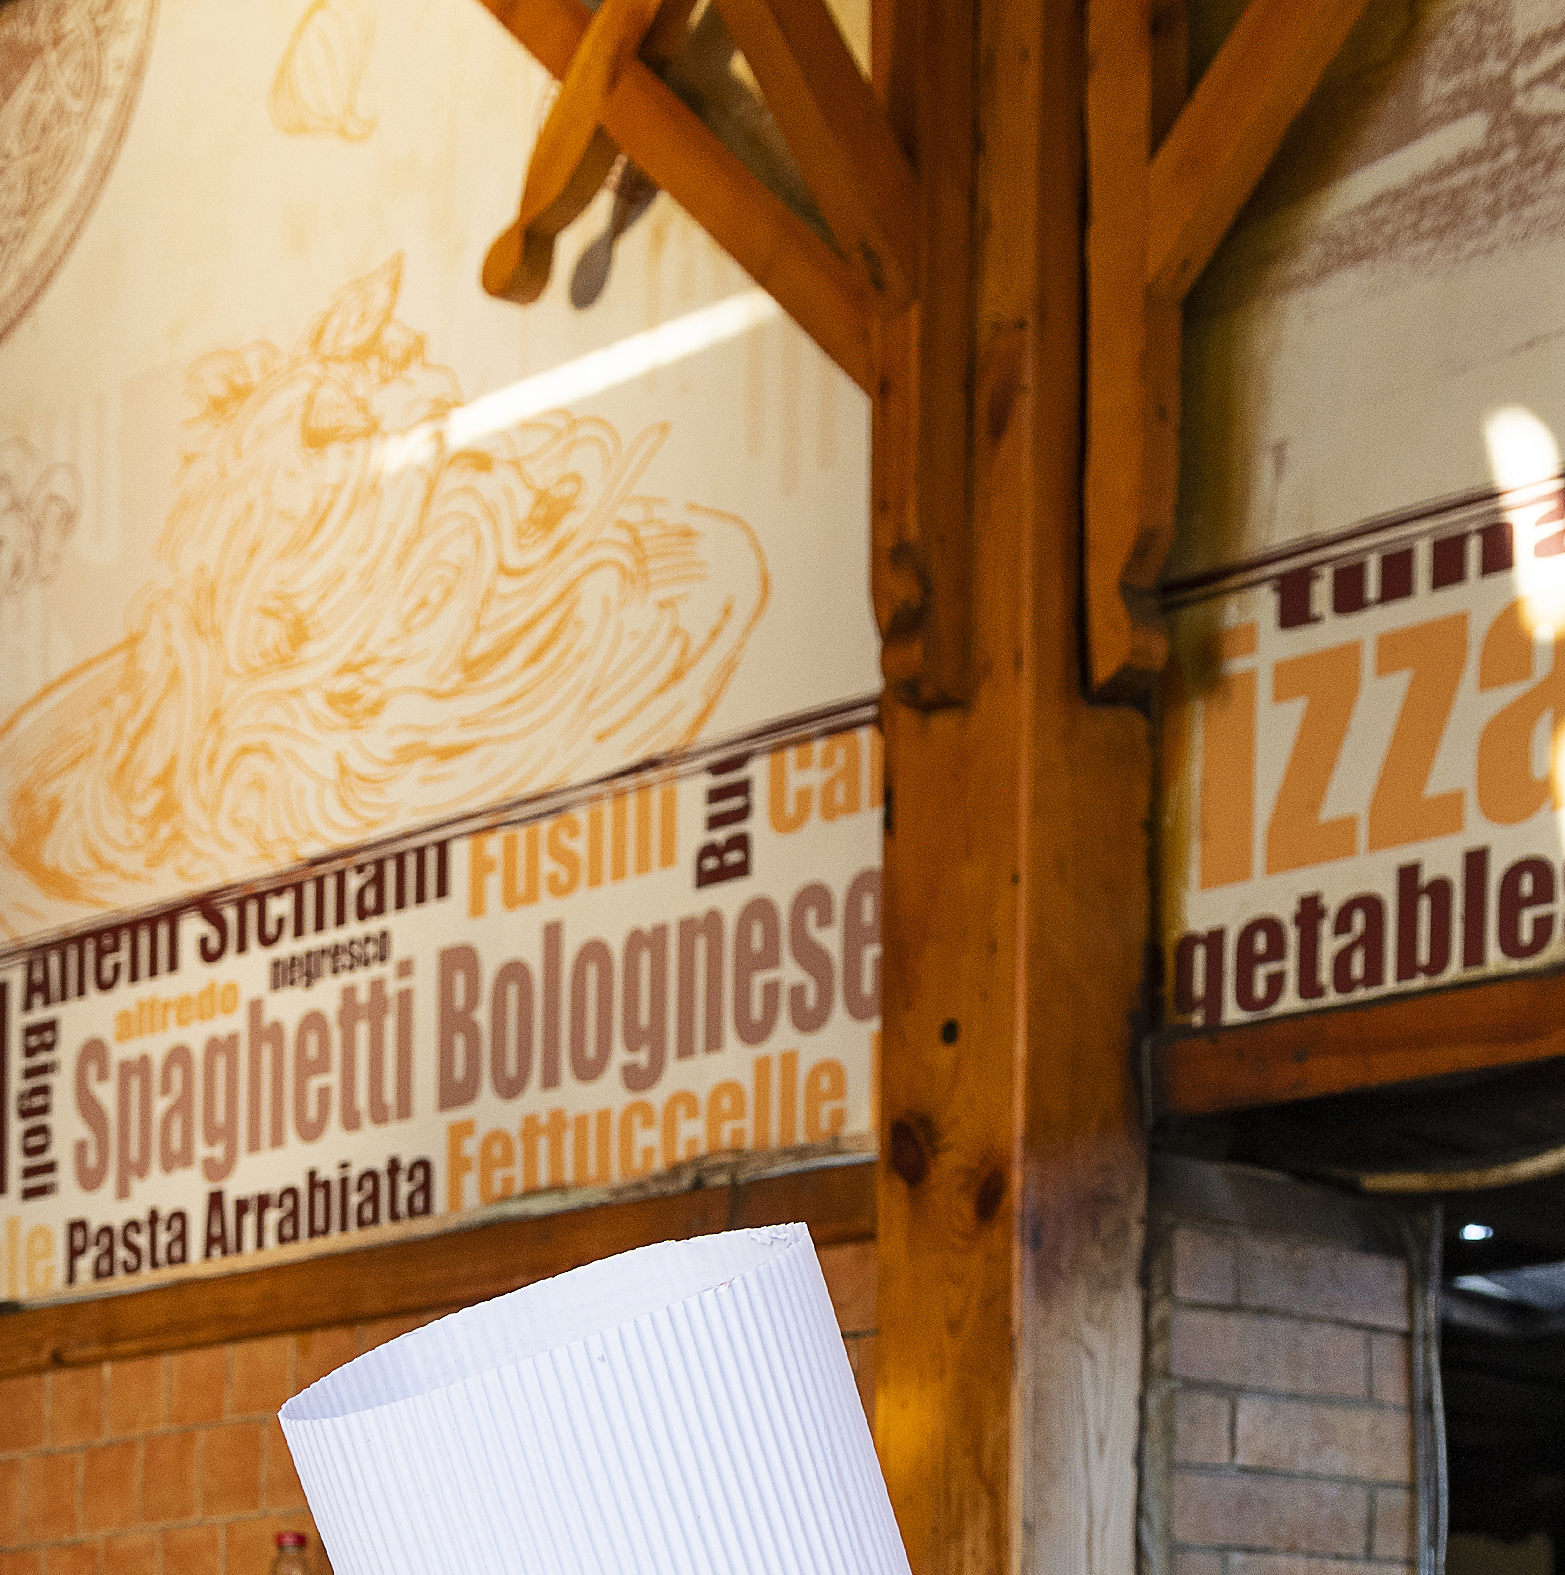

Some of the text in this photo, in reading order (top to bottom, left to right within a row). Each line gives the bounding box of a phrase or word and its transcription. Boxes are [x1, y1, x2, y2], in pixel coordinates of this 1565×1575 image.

[1198, 590, 1565, 891] izza
[467, 783, 678, 919] Fusilli
[114, 980, 240, 1044] alfredo
[269, 931, 392, 991] negresco
[1174, 845, 1565, 1027] getable
[18, 1017, 60, 1201] Bigoli
[73, 867, 881, 1200] Spaghetti Bolognese
[446, 1051, 847, 1213] Fettuccelle
[67, 1155, 434, 1287] Pasta Arrabiata
